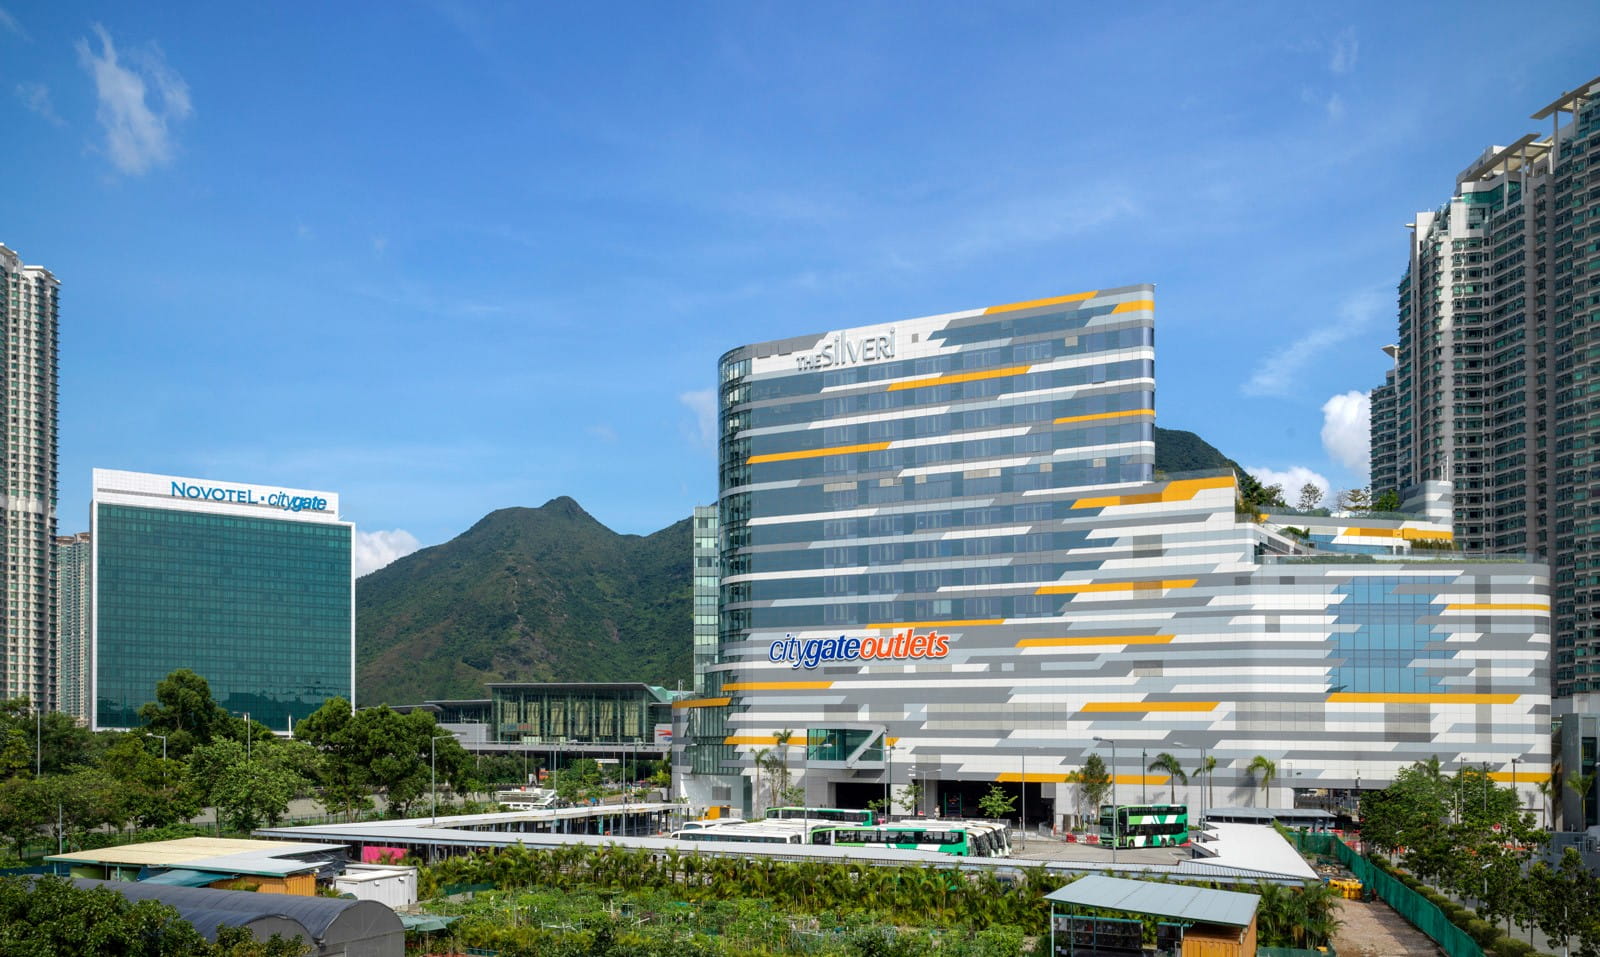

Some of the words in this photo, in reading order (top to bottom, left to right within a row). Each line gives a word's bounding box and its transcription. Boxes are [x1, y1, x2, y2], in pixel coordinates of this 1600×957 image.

[796, 354, 821, 372] THE
[171, 481, 258, 504] NOVOTEL
[268, 491, 327, 512] citygate
